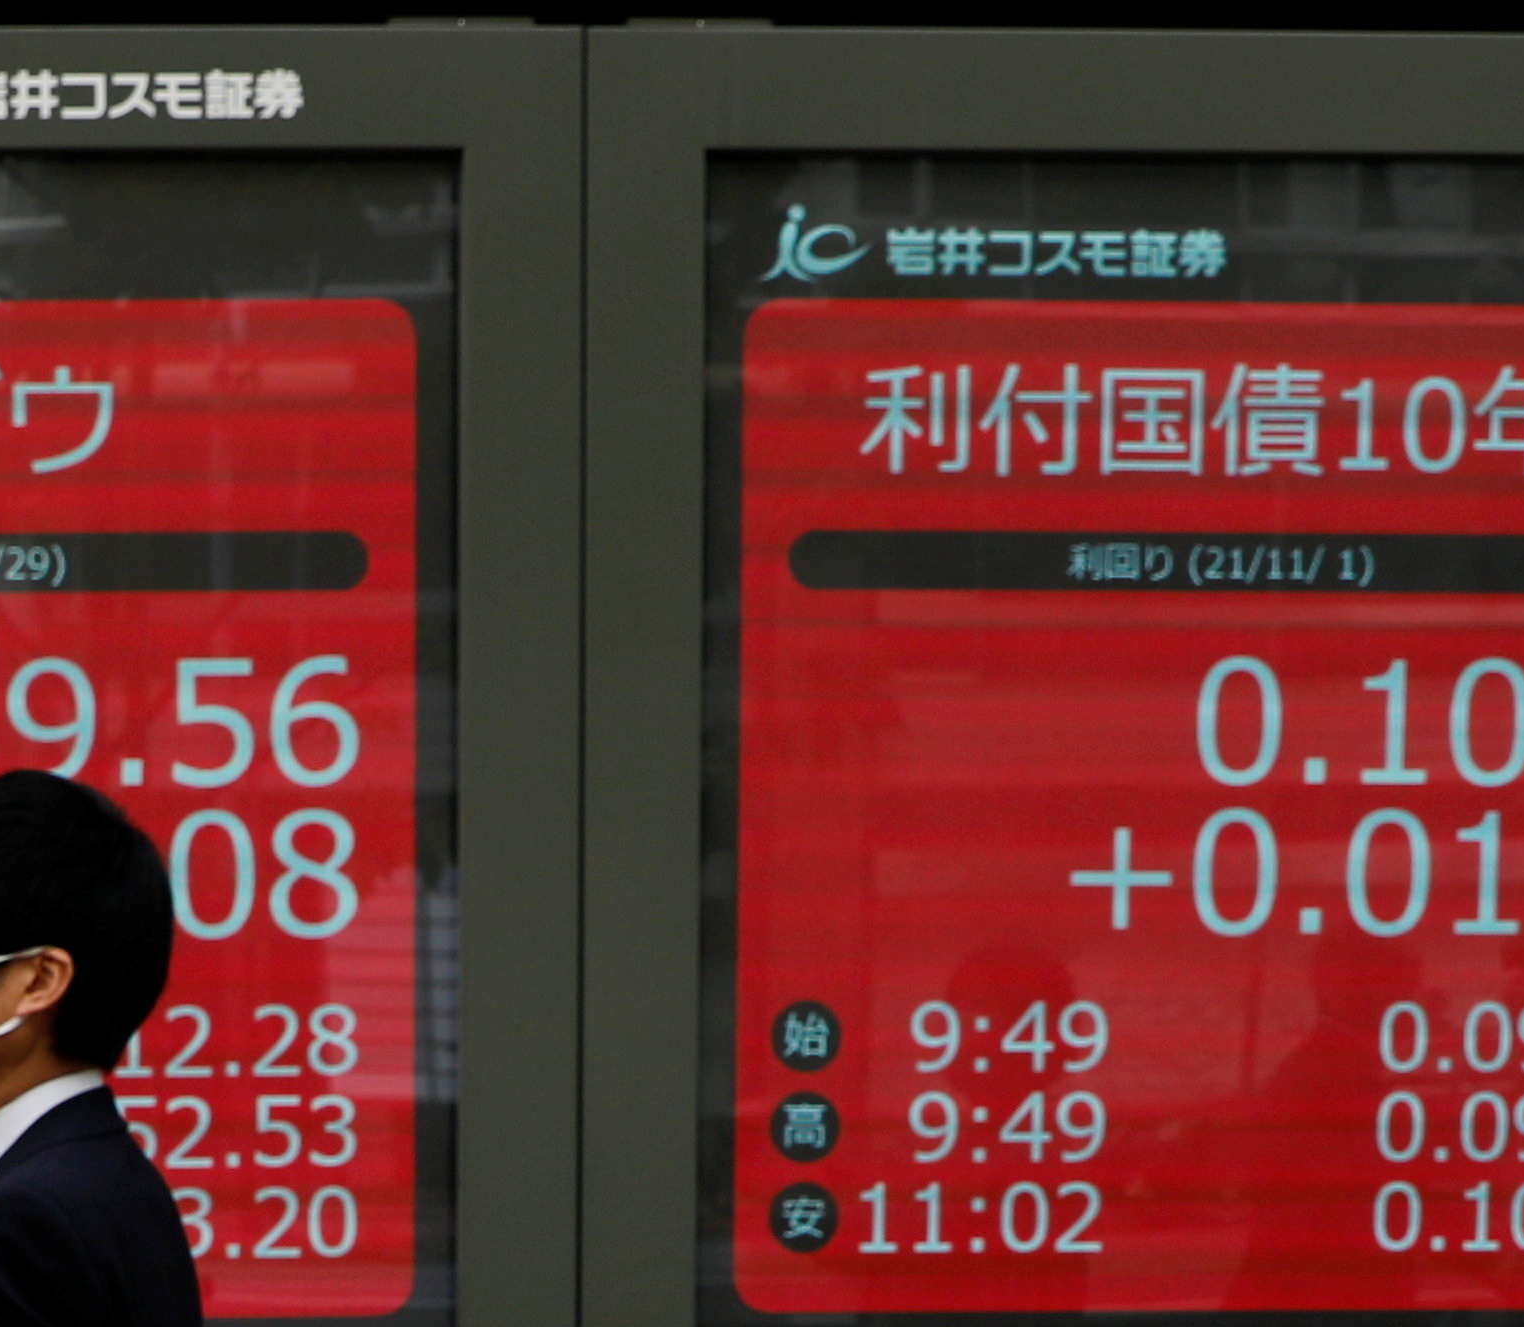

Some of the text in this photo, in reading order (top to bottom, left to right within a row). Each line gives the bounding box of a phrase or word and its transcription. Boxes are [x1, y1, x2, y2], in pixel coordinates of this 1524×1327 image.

[885, 225, 1227, 278] 岩井コスモ証券
[1067, 543, 1173, 581] 利回り
[114, 1003, 359, 1078] 12.28
[783, 1012, 830, 1057] 始
[914, 1002, 1107, 1070] 9:49
[783, 1103, 827, 1148] 高
[912, 1093, 1104, 1160] 9:49
[171, 1185, 358, 1261] 3.20
[783, 1197, 825, 1238] 安
[863, 1183, 1100, 1252] 11:02
